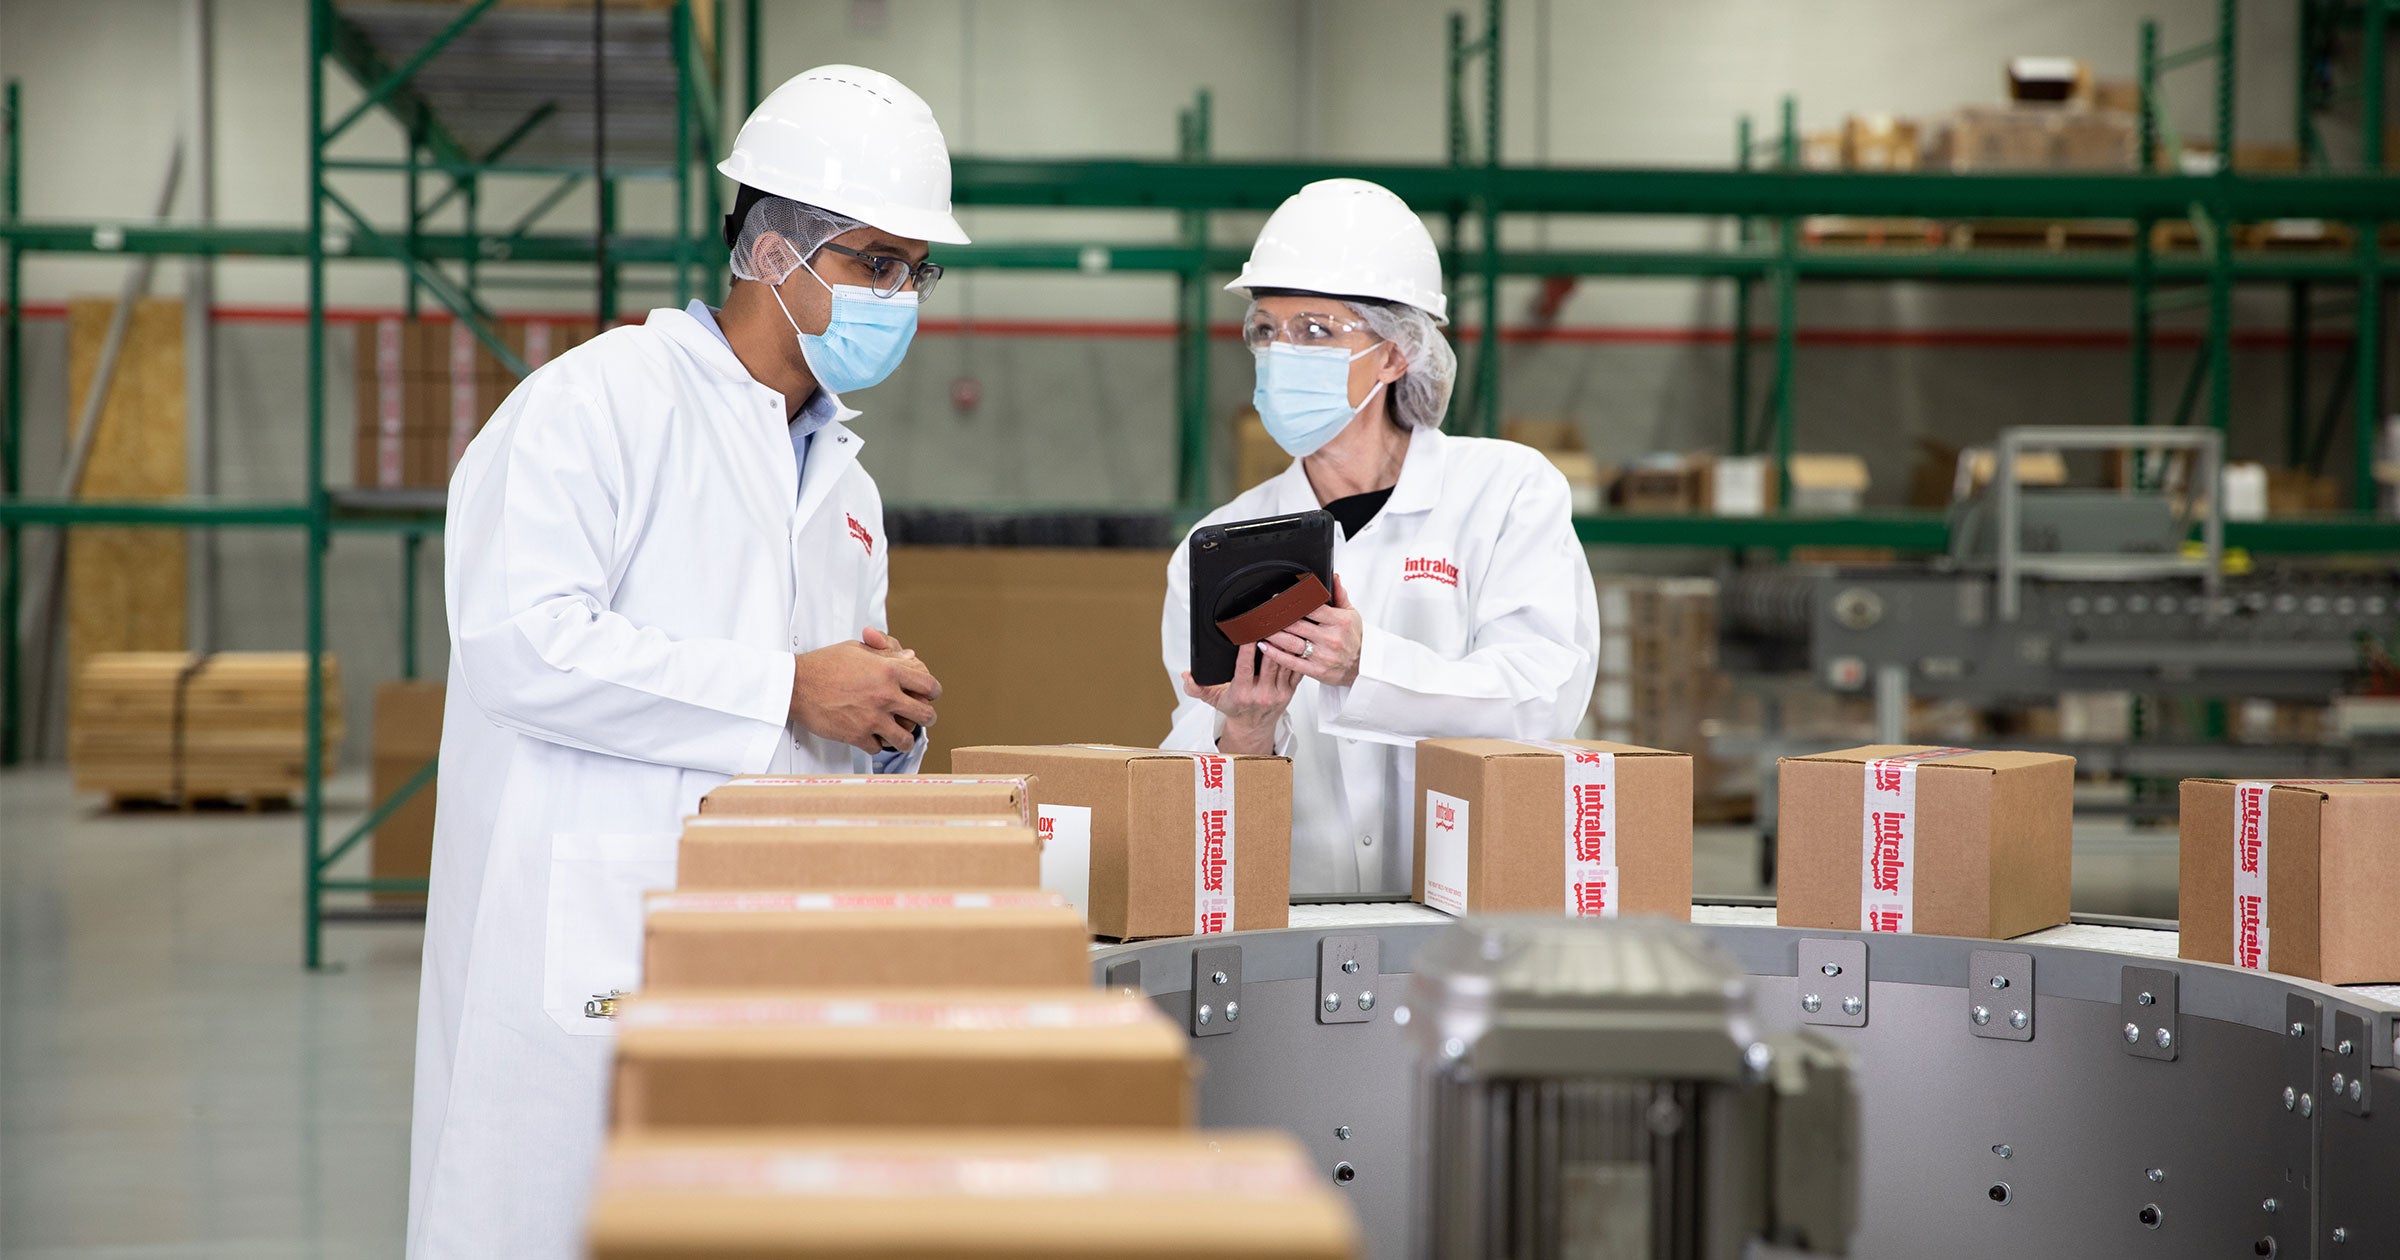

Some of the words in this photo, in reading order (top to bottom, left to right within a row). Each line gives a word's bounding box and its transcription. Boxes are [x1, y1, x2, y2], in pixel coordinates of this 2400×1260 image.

[1404, 557, 1459, 578] intralox
[1210, 810, 1227, 891] intralox
[1585, 784, 1606, 862] intralox
[1882, 812, 1905, 892] intralox
[2247, 788, 2263, 873] intralox
